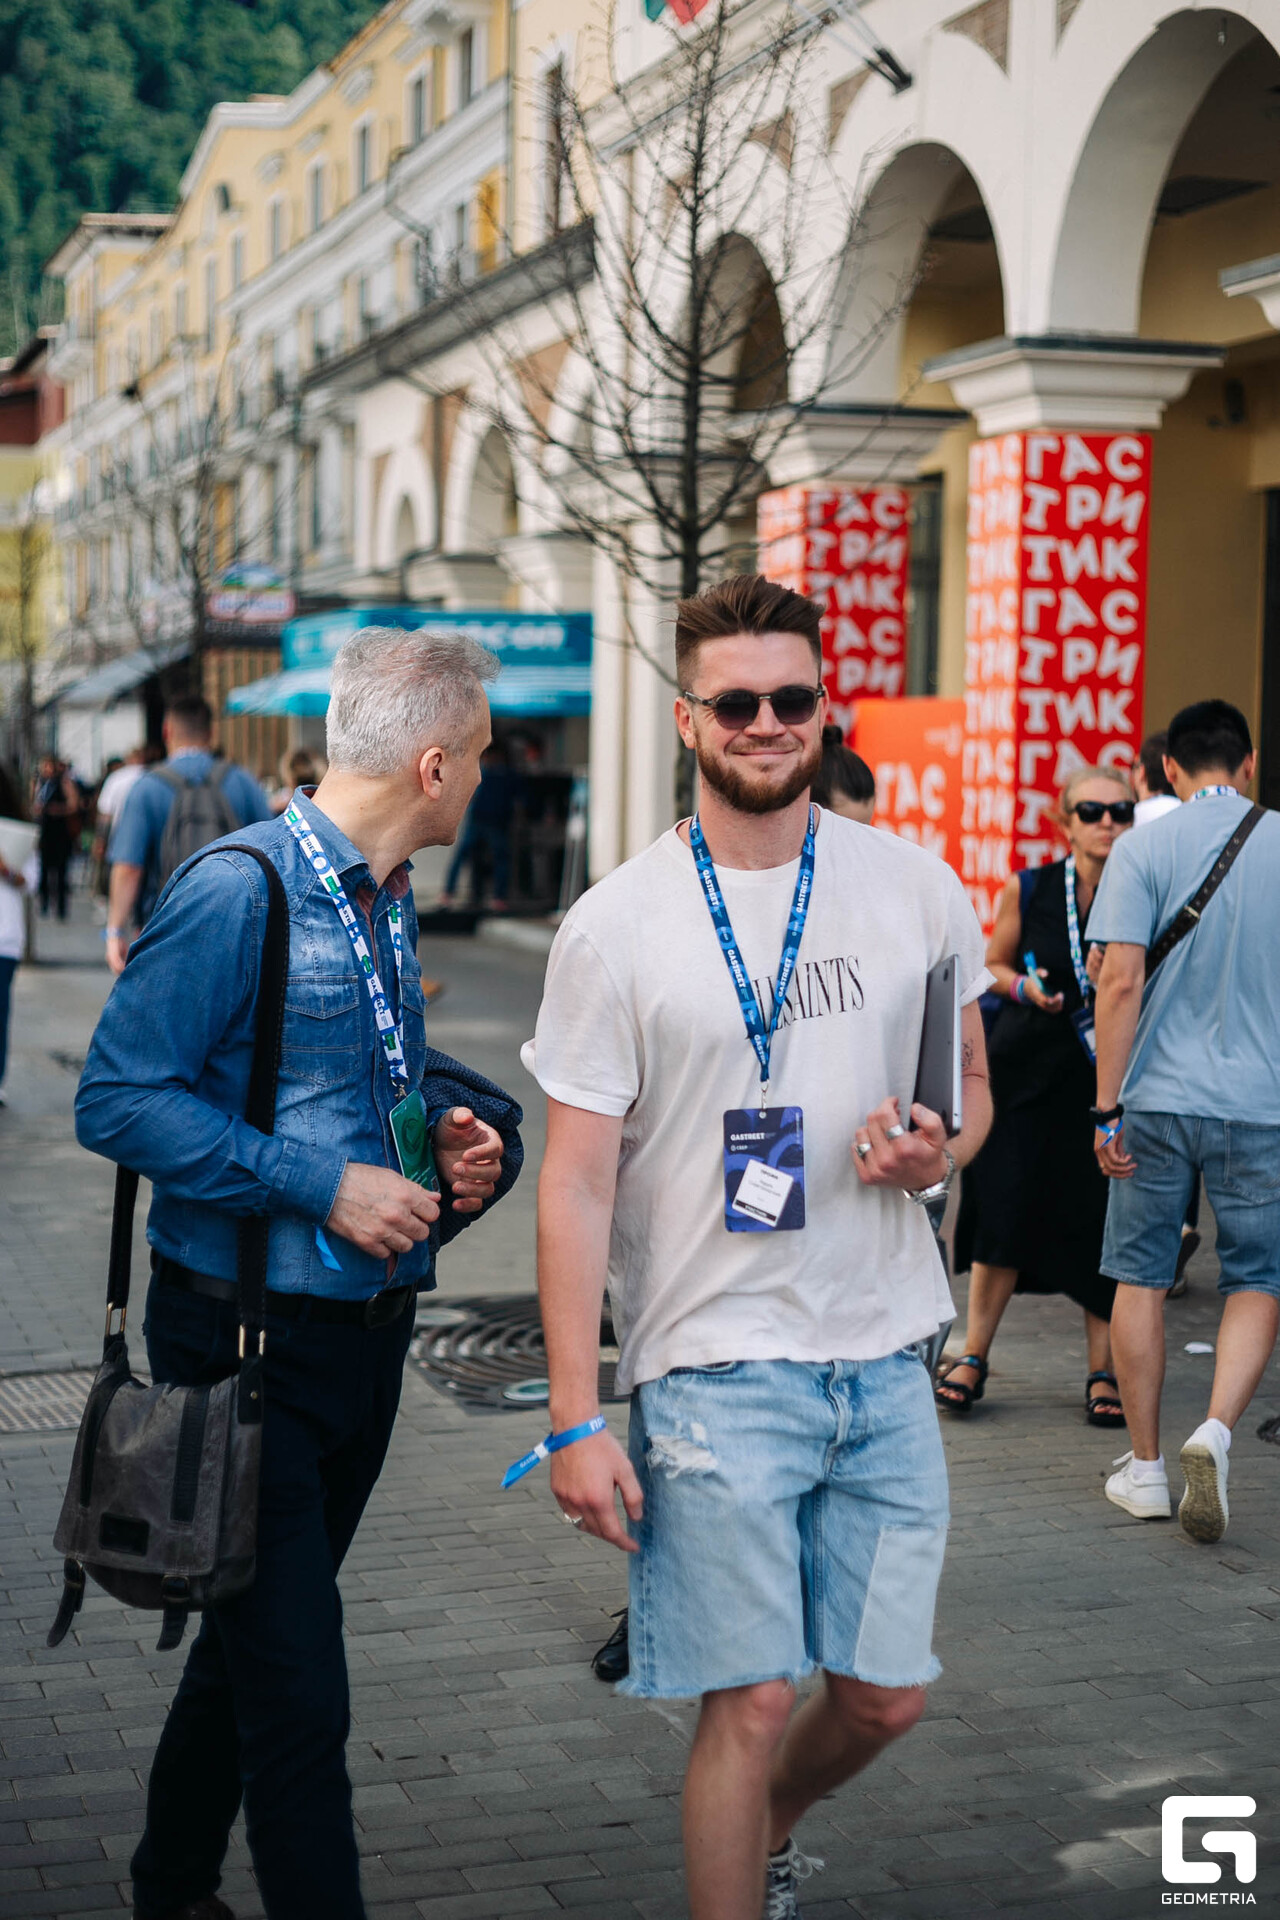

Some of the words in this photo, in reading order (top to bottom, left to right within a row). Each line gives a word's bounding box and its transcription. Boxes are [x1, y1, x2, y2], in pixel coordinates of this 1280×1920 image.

[1025, 433, 1144, 482] ГАС
[1022, 481, 1146, 534] ТРИ
[1021, 532, 1139, 585] ТИК
[1021, 586, 1139, 636] ГАС
[1019, 634, 1141, 687] ТРИ
[1018, 685, 1135, 737] ТИК
[875, 761, 948, 821] ГАС
[703, 869, 719, 906] GASTREET
[796, 875, 809, 913] GASTREET
[728, 949, 746, 988] GASTREET
[778, 957, 792, 997] GASTREET
[730, 1132, 765, 1141] GASTREET
